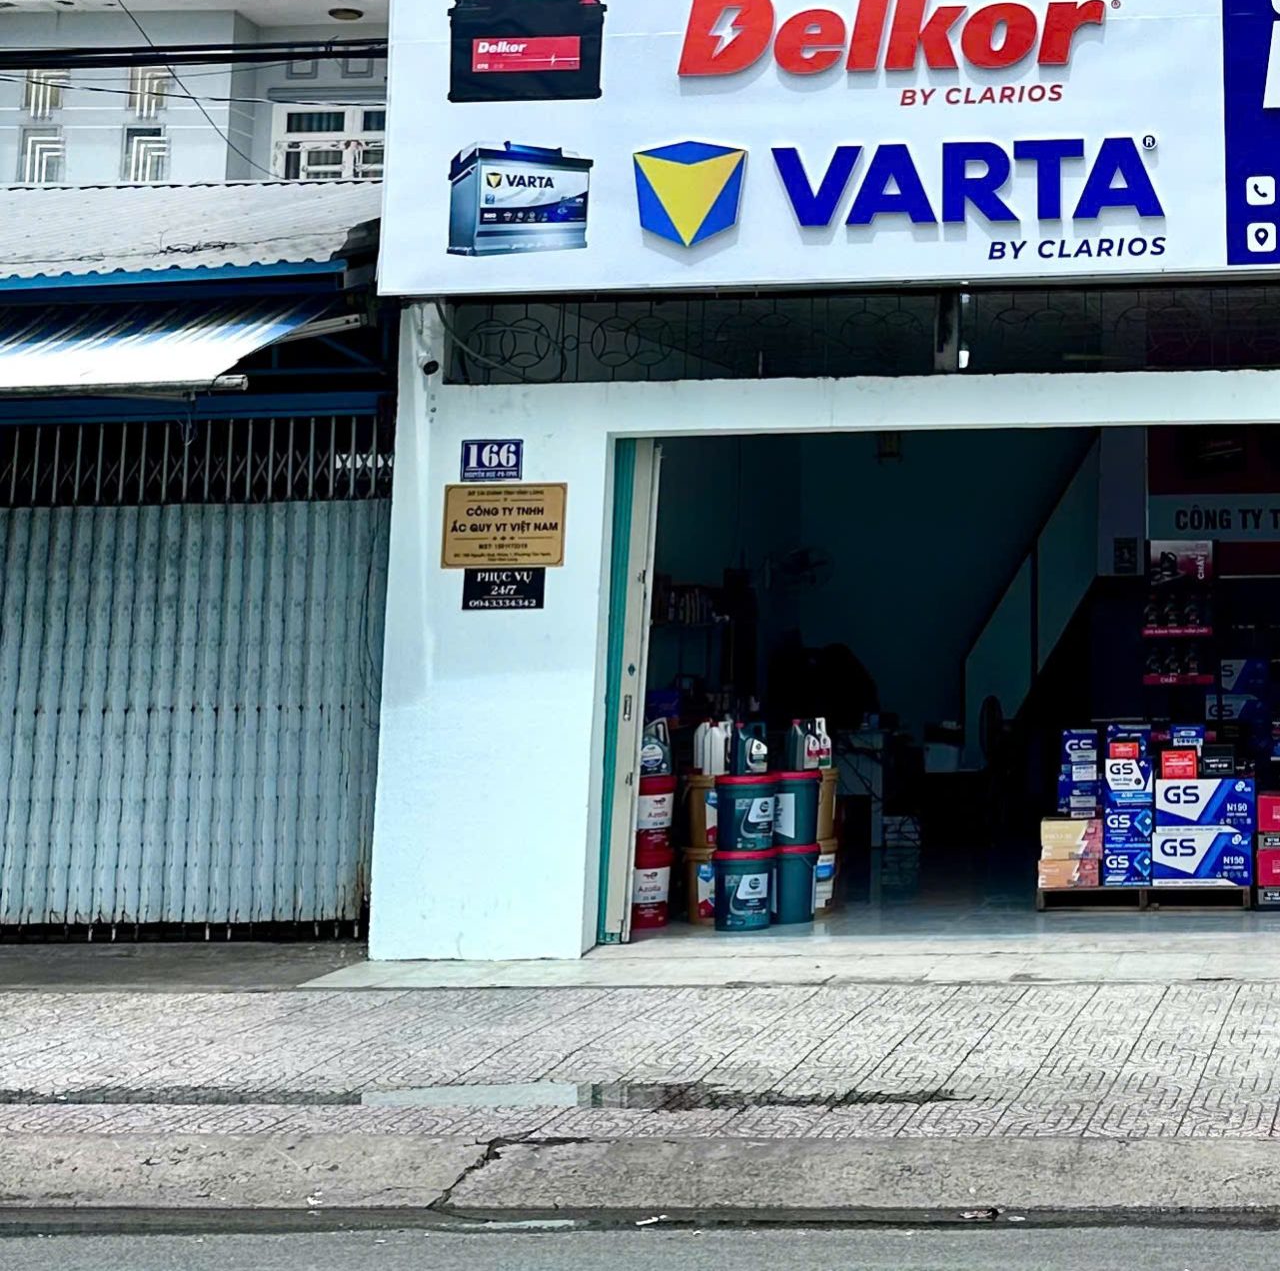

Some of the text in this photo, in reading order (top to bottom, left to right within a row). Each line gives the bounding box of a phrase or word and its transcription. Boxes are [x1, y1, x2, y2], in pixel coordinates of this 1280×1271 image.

[477, 41, 527, 54] Delkor
[901, 83, 1065, 107] BY CLARIOS
[506, 174, 555, 189] VARTA
[771, 136, 1166, 227] VARTA
[987, 236, 1168, 261] BY CLARIOS
[467, 444, 517, 468] 166
[466, 504, 544, 517] CÔNG TY TNHH
[1175, 504, 1232, 530] CÔNG
[1238, 508, 1263, 529] TY
[470, 523, 492, 533] QUY
[495, 523, 508, 532] VT
[511, 521, 531, 535] VIỆT
[534, 522, 558, 532] NAM
[477, 571, 533, 584] PHỤC VỤ
[490, 586, 517, 595] 24/7
[1110, 763, 1134, 775] GS
[1164, 785, 1200, 804] GS
[1107, 815, 1131, 828] GS
[1160, 838, 1197, 857] GS
[1106, 855, 1129, 868] GS
